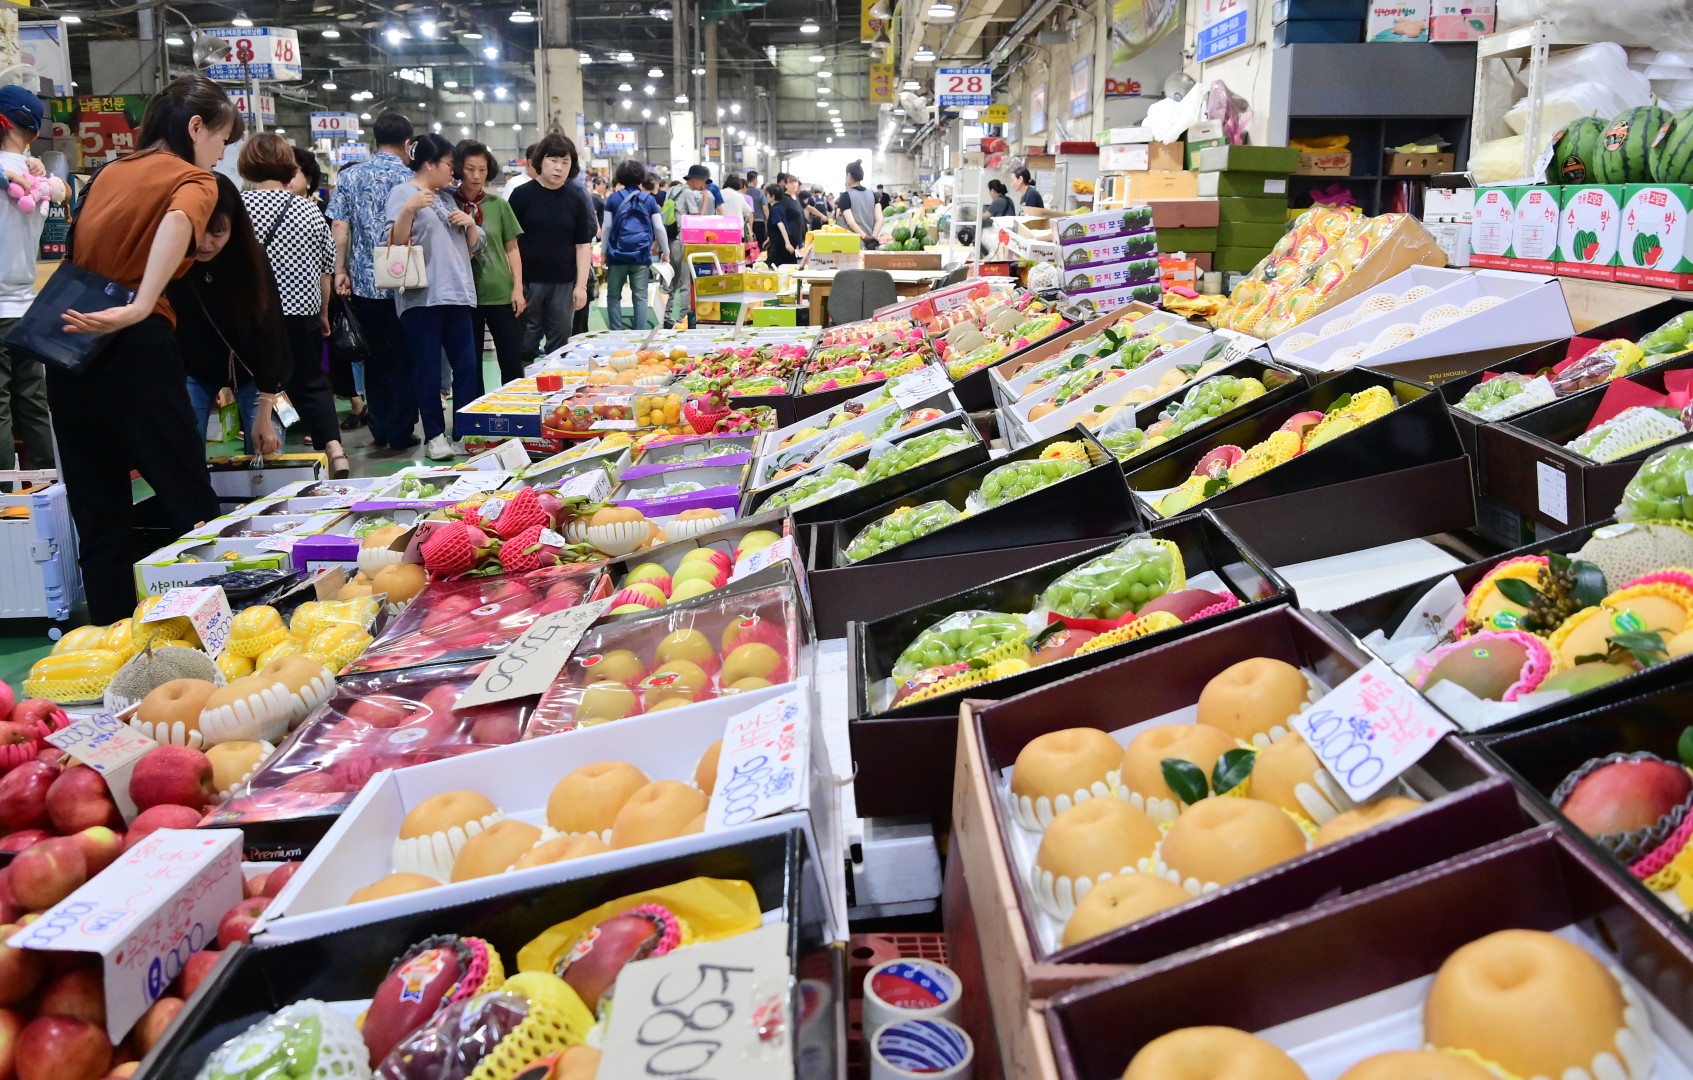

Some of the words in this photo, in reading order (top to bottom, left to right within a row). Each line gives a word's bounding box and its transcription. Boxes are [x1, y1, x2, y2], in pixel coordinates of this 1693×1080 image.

[275, 39, 294, 62] 48
[948, 76, 983, 93] 28
[1105, 77, 1141, 94] Dole
[318, 118, 340, 129] 40
[1304, 709, 1384, 788] 40,000
[250, 847, 302, 860] Premium
[636, 963, 755, 1080] 580
